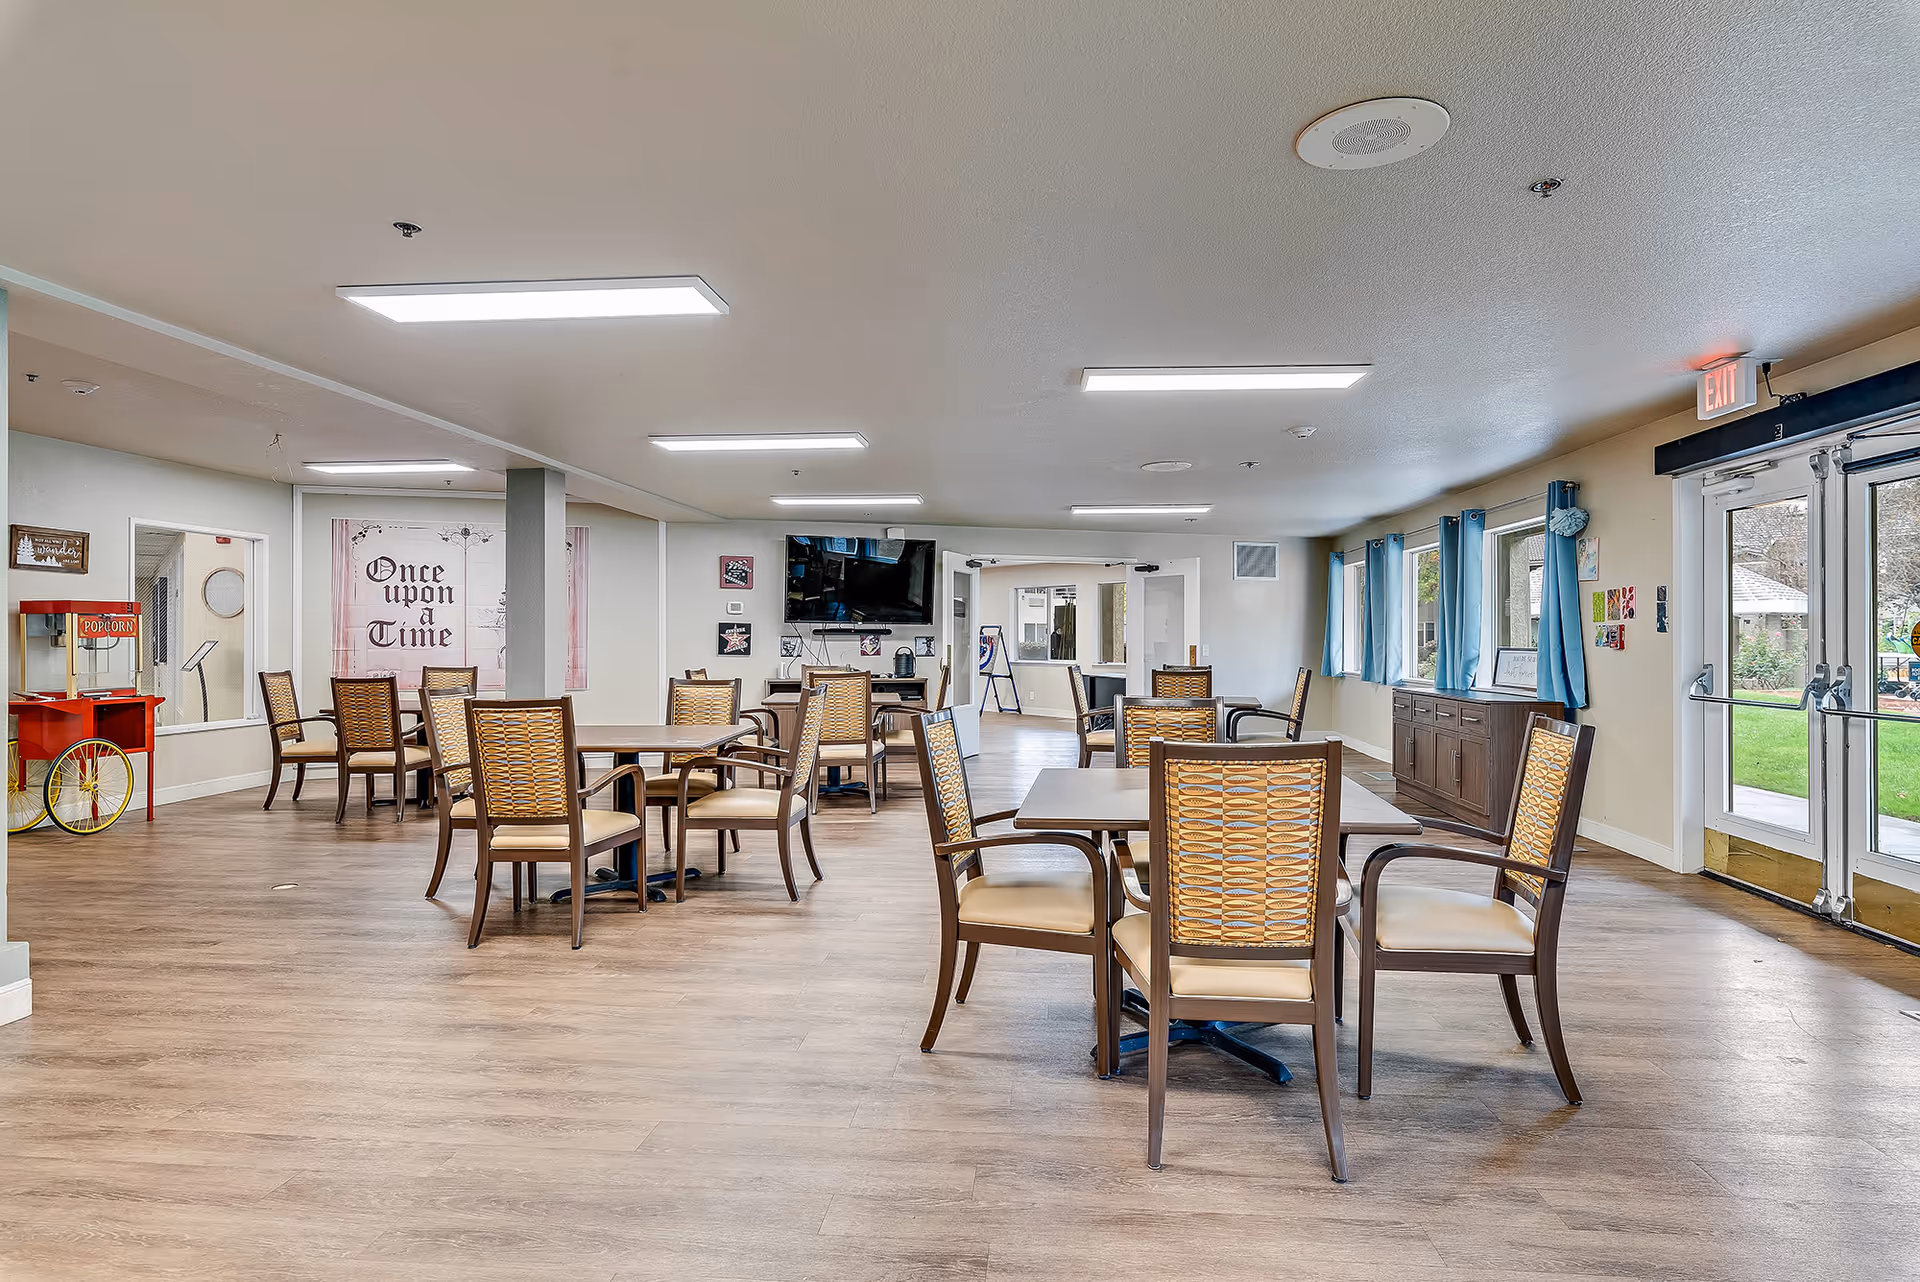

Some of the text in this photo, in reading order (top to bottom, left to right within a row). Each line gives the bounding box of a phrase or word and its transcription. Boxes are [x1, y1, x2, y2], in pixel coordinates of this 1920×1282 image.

[1704, 363, 1737, 413] EXIT
[37, 539, 80, 558] wander
[366, 555, 445, 584] Once
[383, 584, 455, 609] upon
[84, 620, 133, 632] POPCORN
[419, 606, 436, 626] a
[366, 619, 453, 648] Time
